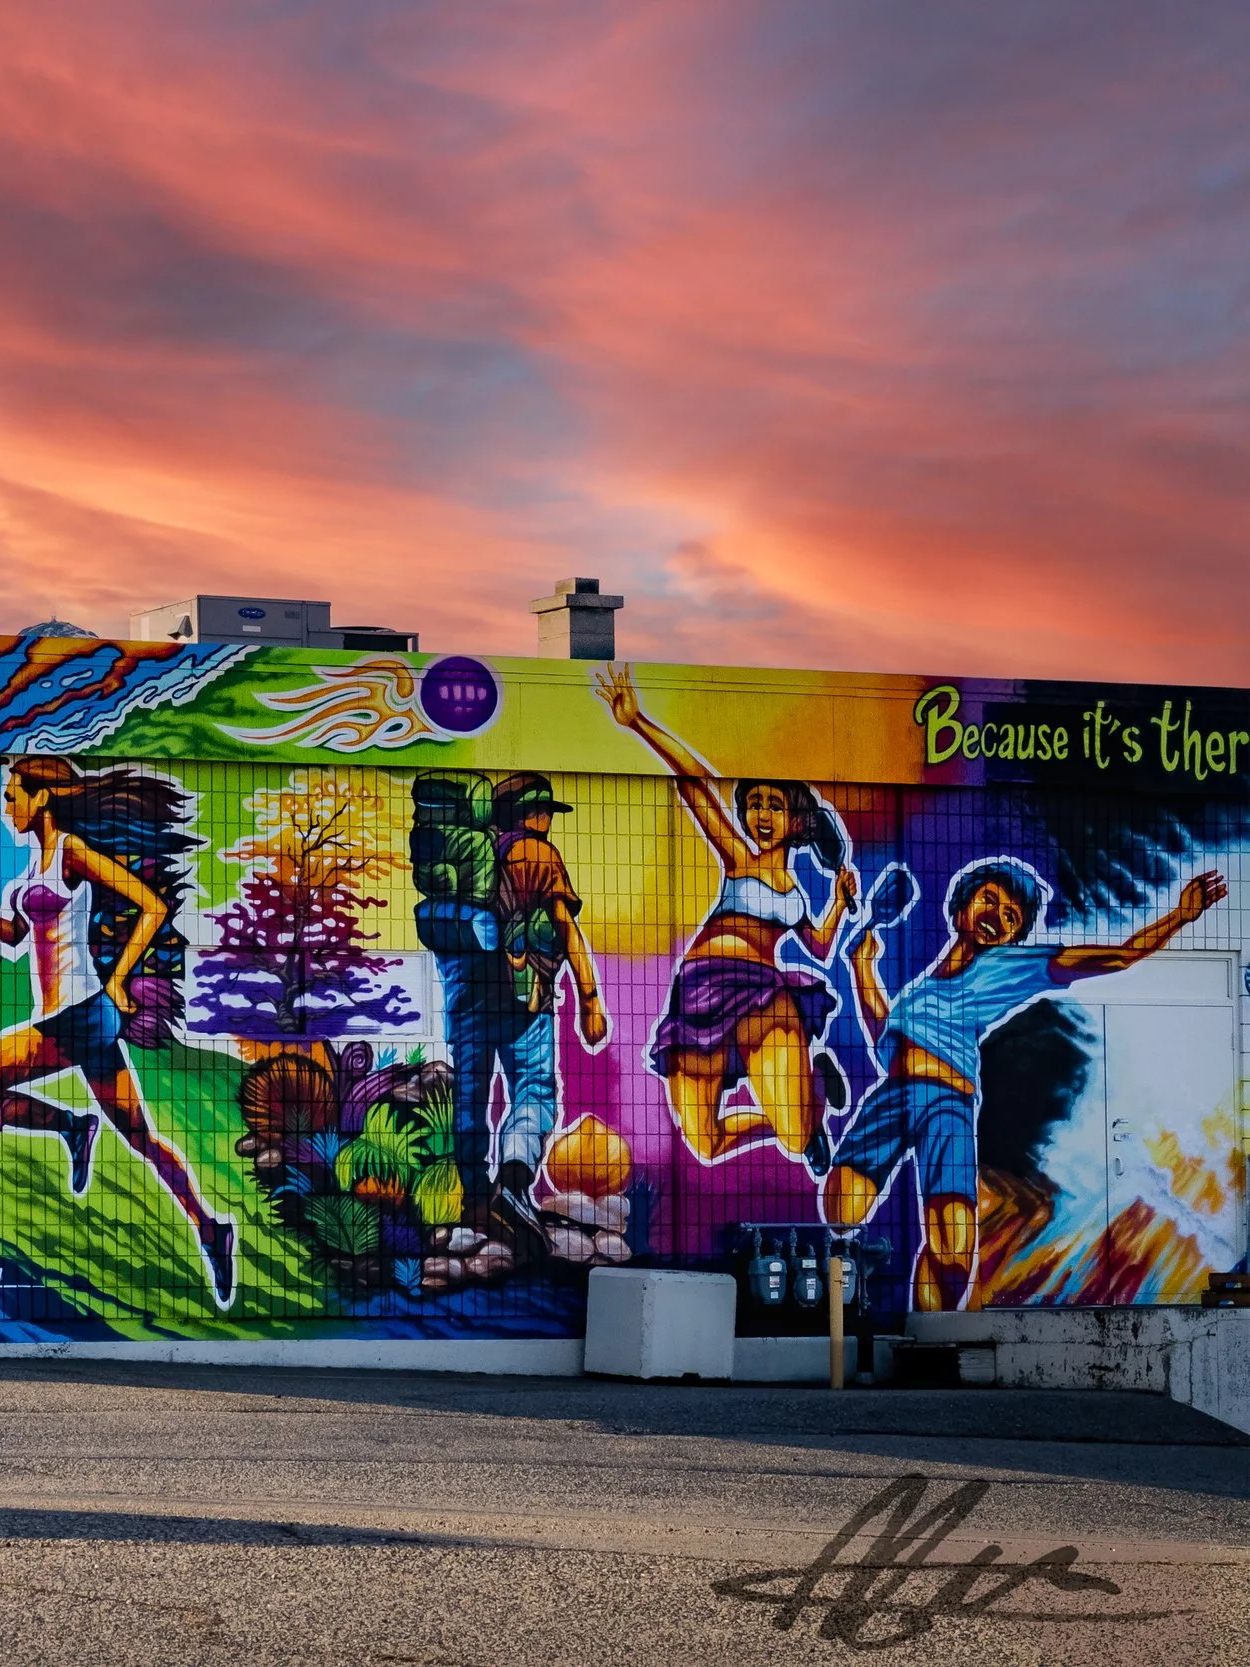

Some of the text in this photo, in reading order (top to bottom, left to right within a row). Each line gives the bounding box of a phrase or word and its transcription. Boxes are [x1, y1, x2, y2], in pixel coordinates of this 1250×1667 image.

[915, 685, 1250, 781] Because it's ther
